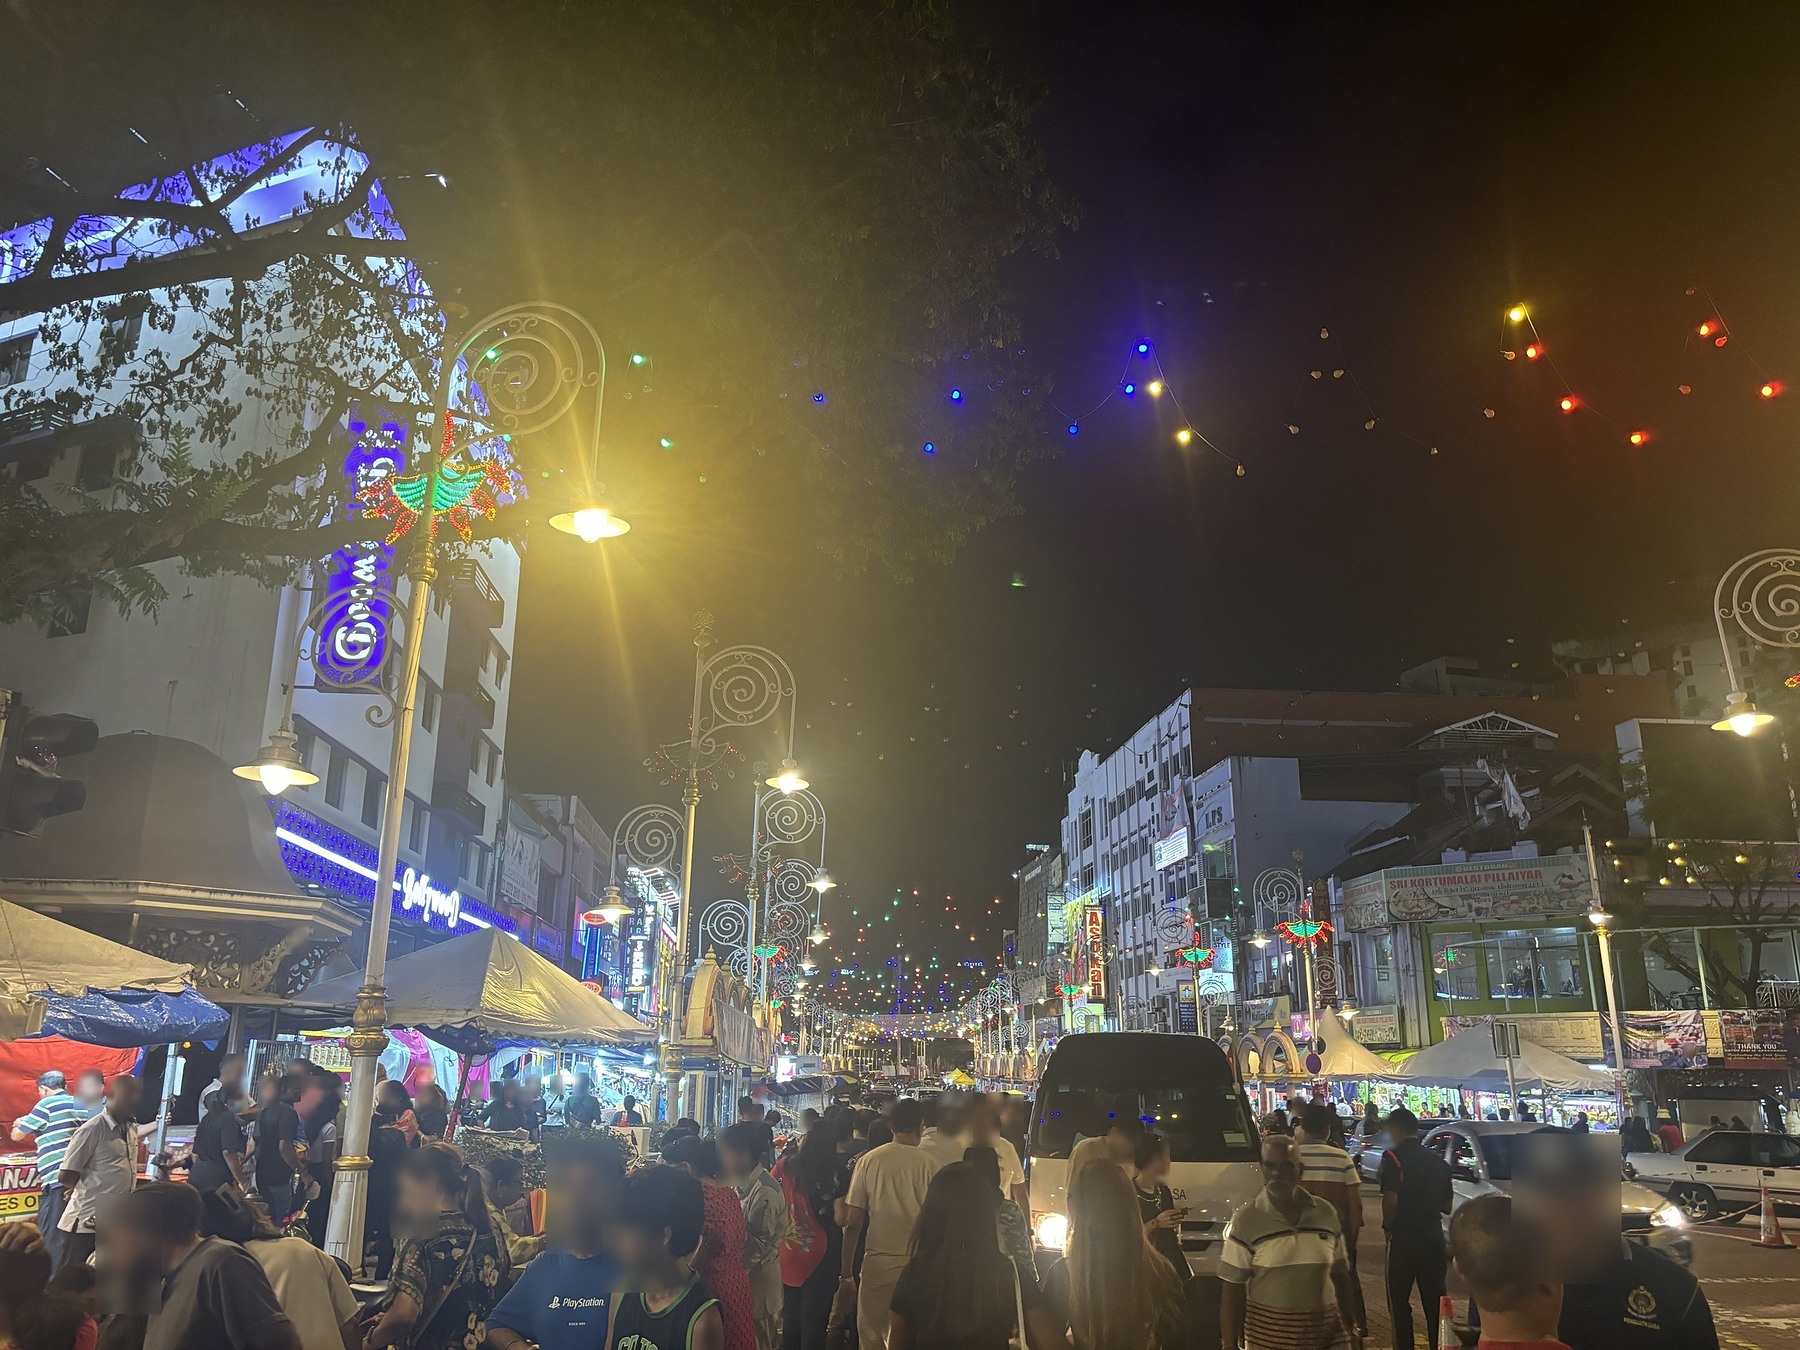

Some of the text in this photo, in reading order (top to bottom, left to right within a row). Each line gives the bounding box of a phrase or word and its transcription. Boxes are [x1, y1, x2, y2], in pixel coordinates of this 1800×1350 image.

[1389, 879, 1408, 889] SRI
[1411, 873, 1482, 888] KORTUMALAI
[1484, 870, 1542, 882] PILLAIYAR
[562, 1297, 605, 1310] PlayStation
